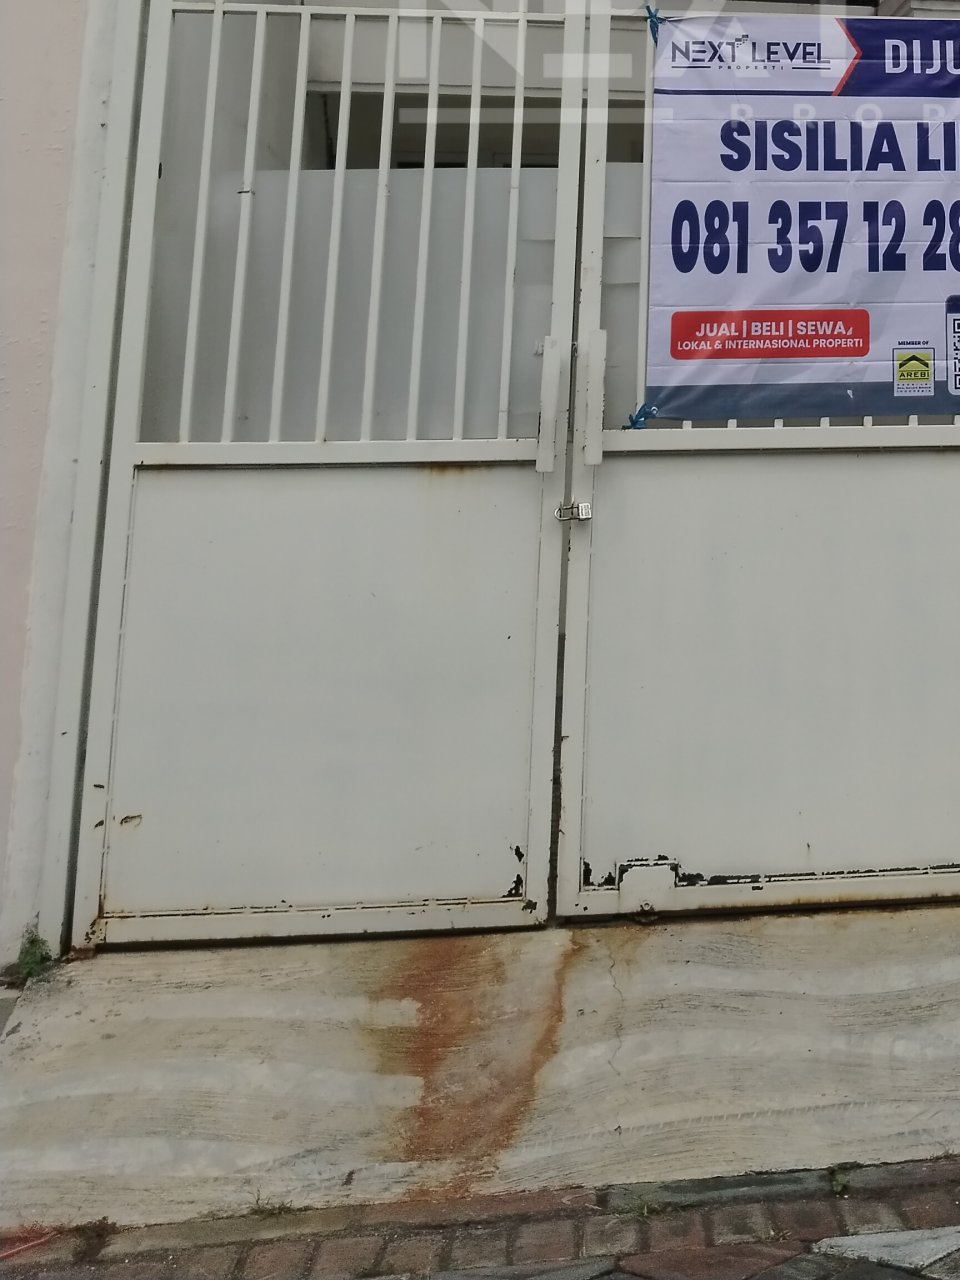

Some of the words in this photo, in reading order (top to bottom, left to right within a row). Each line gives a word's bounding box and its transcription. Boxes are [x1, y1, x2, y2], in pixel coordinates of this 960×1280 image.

[671, 40, 736, 63] NEXT
[751, 41, 831, 64] LEVEL
[719, 119, 906, 172] SISILIA
[670, 199, 750, 274] 081
[767, 199, 849, 273] 357
[862, 200, 907, 273] 12
[695, 322, 739, 337] JUAL
[751, 321, 784, 336] BELI
[796, 321, 847, 336] SEWA
[677, 340, 712, 351] LOKAL
[714, 340, 723, 350] &
[725, 338, 811, 350] INTERNASIONAL
[812, 338, 863, 349] PROPERTI
